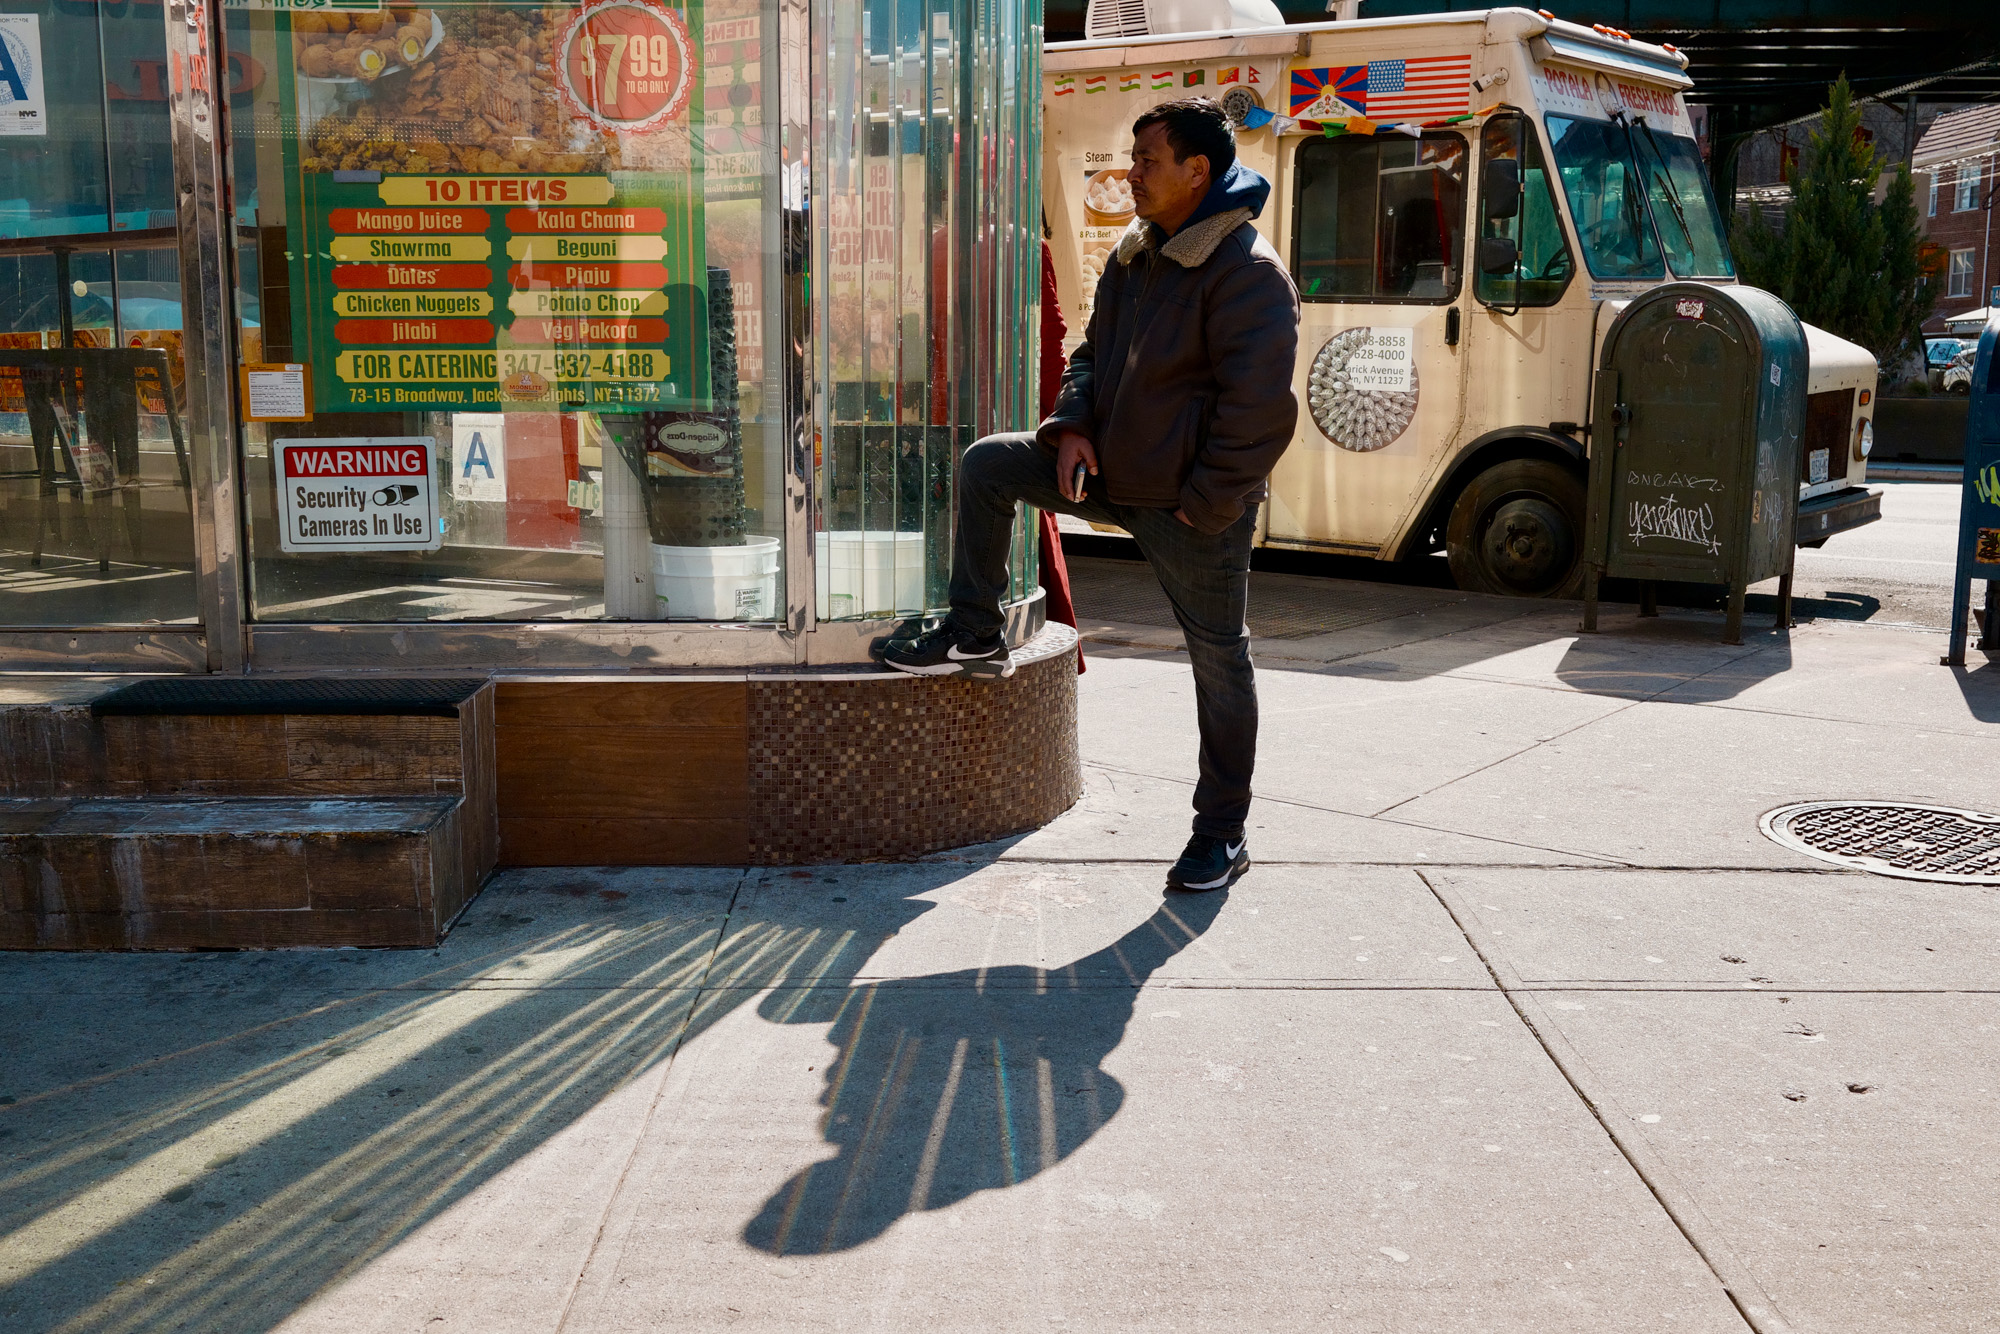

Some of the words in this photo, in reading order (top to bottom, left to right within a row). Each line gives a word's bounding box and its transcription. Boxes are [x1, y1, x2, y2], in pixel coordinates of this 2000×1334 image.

[626, 80, 636, 94] TO
[637, 80, 648, 94] GO
[649, 80, 670, 94] ONLY
[1543, 66, 1594, 102] POTALA
[1617, 83, 1651, 111] FRESH
[1650, 89, 1680, 117] FOOD
[1085, 151, 1113, 163] Steam
[426, 180, 461, 202] 10
[469, 180, 568, 202] ITEMS
[356, 211, 414, 231] Mango
[419, 211, 463, 231] Juice
[537, 211, 576, 229] Kala
[580, 211, 635, 229] Chana
[1079, 230, 1084, 238] 8
[1085, 230, 1096, 238] Pcs
[1097, 230, 1111, 238] Beef
[370, 239, 452, 257] Shawrma
[557, 239, 617, 258] Beguni
[388, 267, 437, 285] Dates
[565, 266, 611, 286] Piaju
[346, 295, 411, 313] Chicken
[416, 294, 481, 314] Nuggets
[537, 294, 592, 312] Potato
[597, 294, 641, 314] Chop
[392, 322, 437, 342] Jilabi
[541, 322, 573, 341] Veg
[580, 321, 638, 340] Pakora
[1354, 349, 1405, 361] 628-4000
[352, 354, 391, 379] FOR
[398, 354, 497, 379] CATERING
[504, 353, 654, 378] 347-932-4188
[1346, 365, 1368, 374] arick
[1370, 366, 1404, 375] Avenue
[1364, 376, 1376, 384] NY
[1378, 376, 1404, 385] 11237
[349, 388, 391, 403] 73-15
[395, 388, 468, 404] Broadway,
[472, 388, 526, 404] Jacks
[537, 388, 590, 404] eights,
[594, 388, 615, 402] NY
[618, 387, 660, 402] 11372
[292, 450, 422, 475] WARNING
[296, 485, 367, 512] Security
[298, 514, 368, 538] Cameras
[373, 514, 389, 536] In
[393, 513, 422, 535] Use
